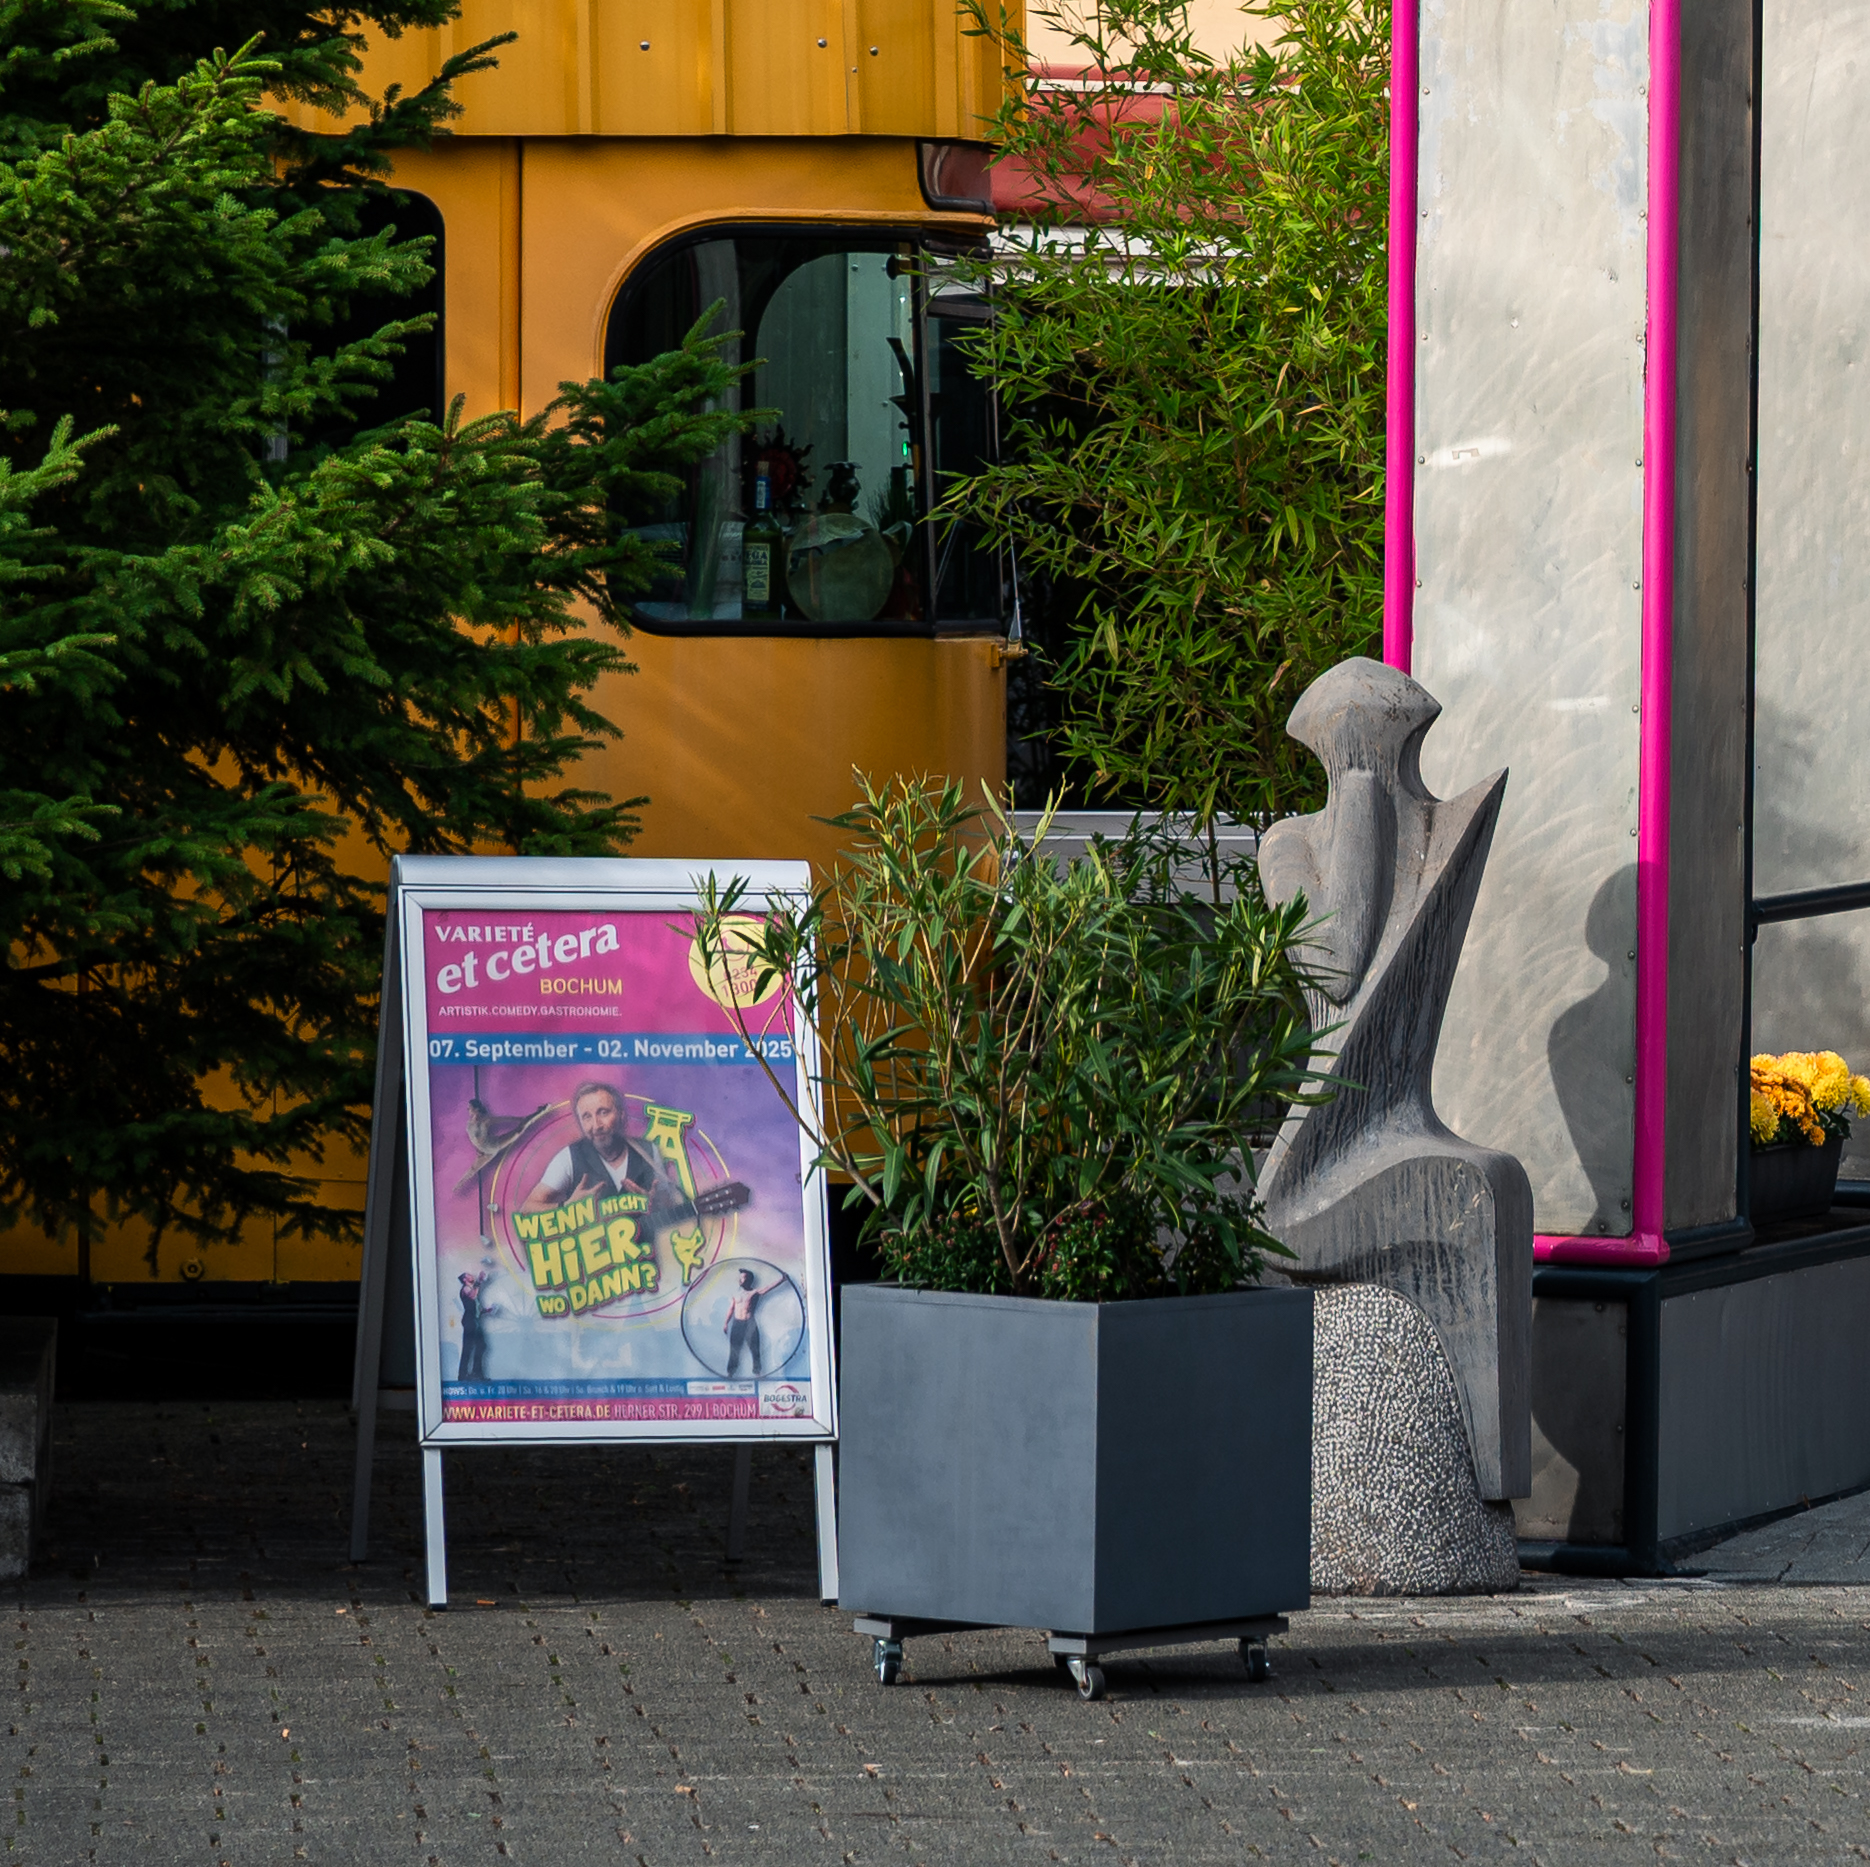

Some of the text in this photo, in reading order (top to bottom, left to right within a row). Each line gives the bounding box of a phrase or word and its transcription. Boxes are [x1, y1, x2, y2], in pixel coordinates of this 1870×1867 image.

[434, 922, 535, 942] VARIETÉ
[436, 923, 620, 994] et cetera
[540, 978, 622, 995] BOCHUM
[429, 1039, 460, 1058] 07.
[465, 1039, 579, 1062] September
[598, 1039, 629, 1058] 02.
[634, 1038, 739, 1058] November
[513, 1196, 596, 1240] WENN
[538, 1263, 657, 1314] WO DANN?
[763, 1393, 808, 1403] BOGESTRA
[613, 1403, 656, 1418] HERNER
[684, 1403, 703, 1418] 299
[712, 1403, 757, 1418] BOCHUM
